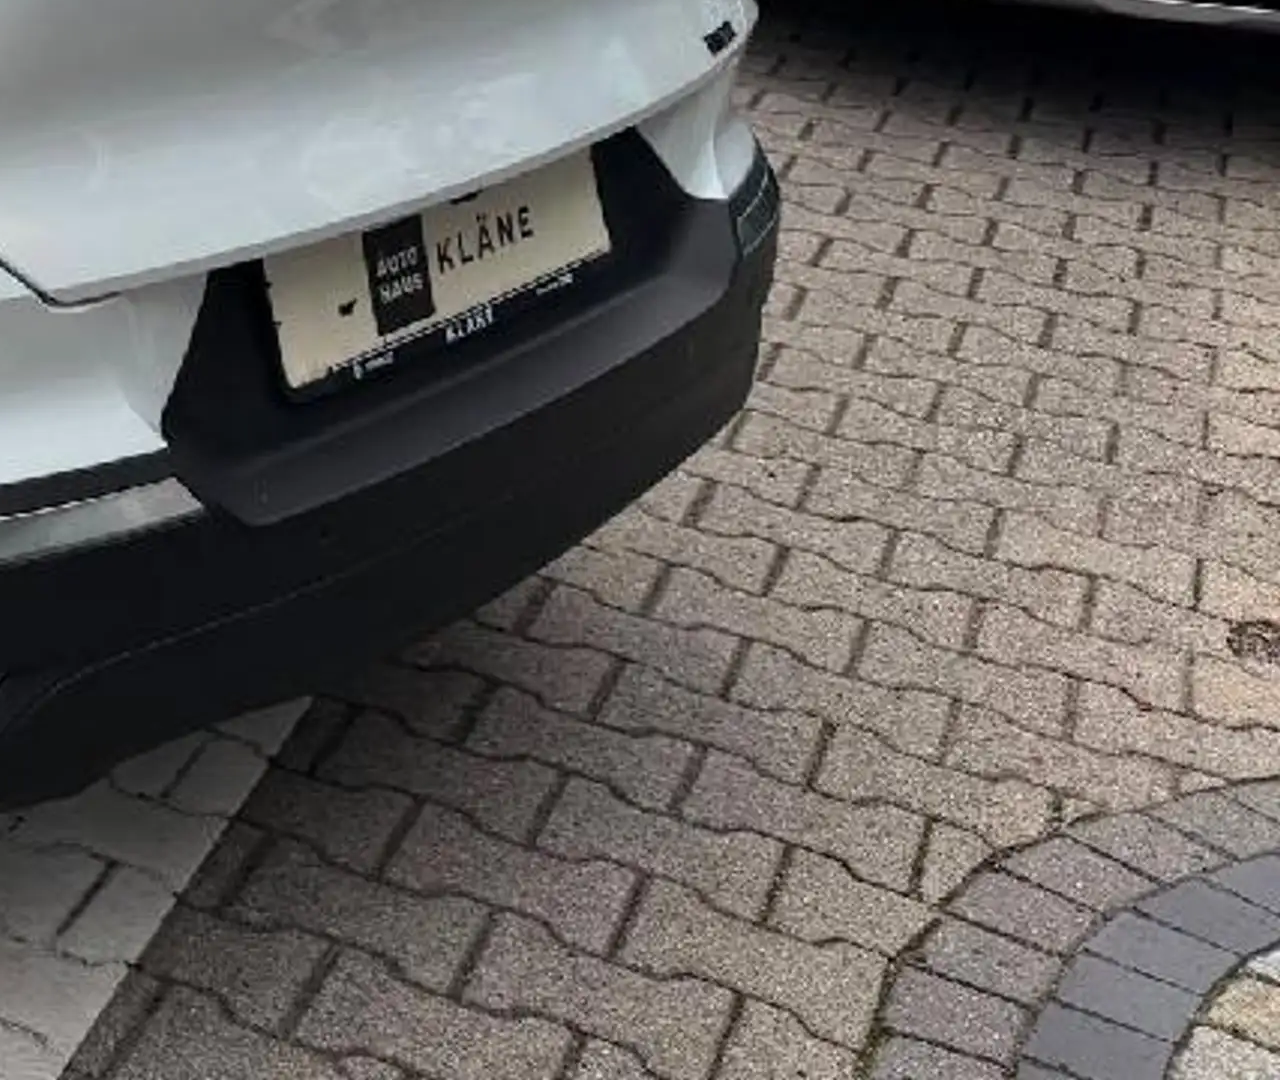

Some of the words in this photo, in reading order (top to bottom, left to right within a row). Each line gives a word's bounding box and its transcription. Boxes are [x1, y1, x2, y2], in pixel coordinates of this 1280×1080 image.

[436, 205, 534, 274] KLÄNE
[376, 245, 419, 278] AUTO
[379, 273, 424, 304] HAUS
